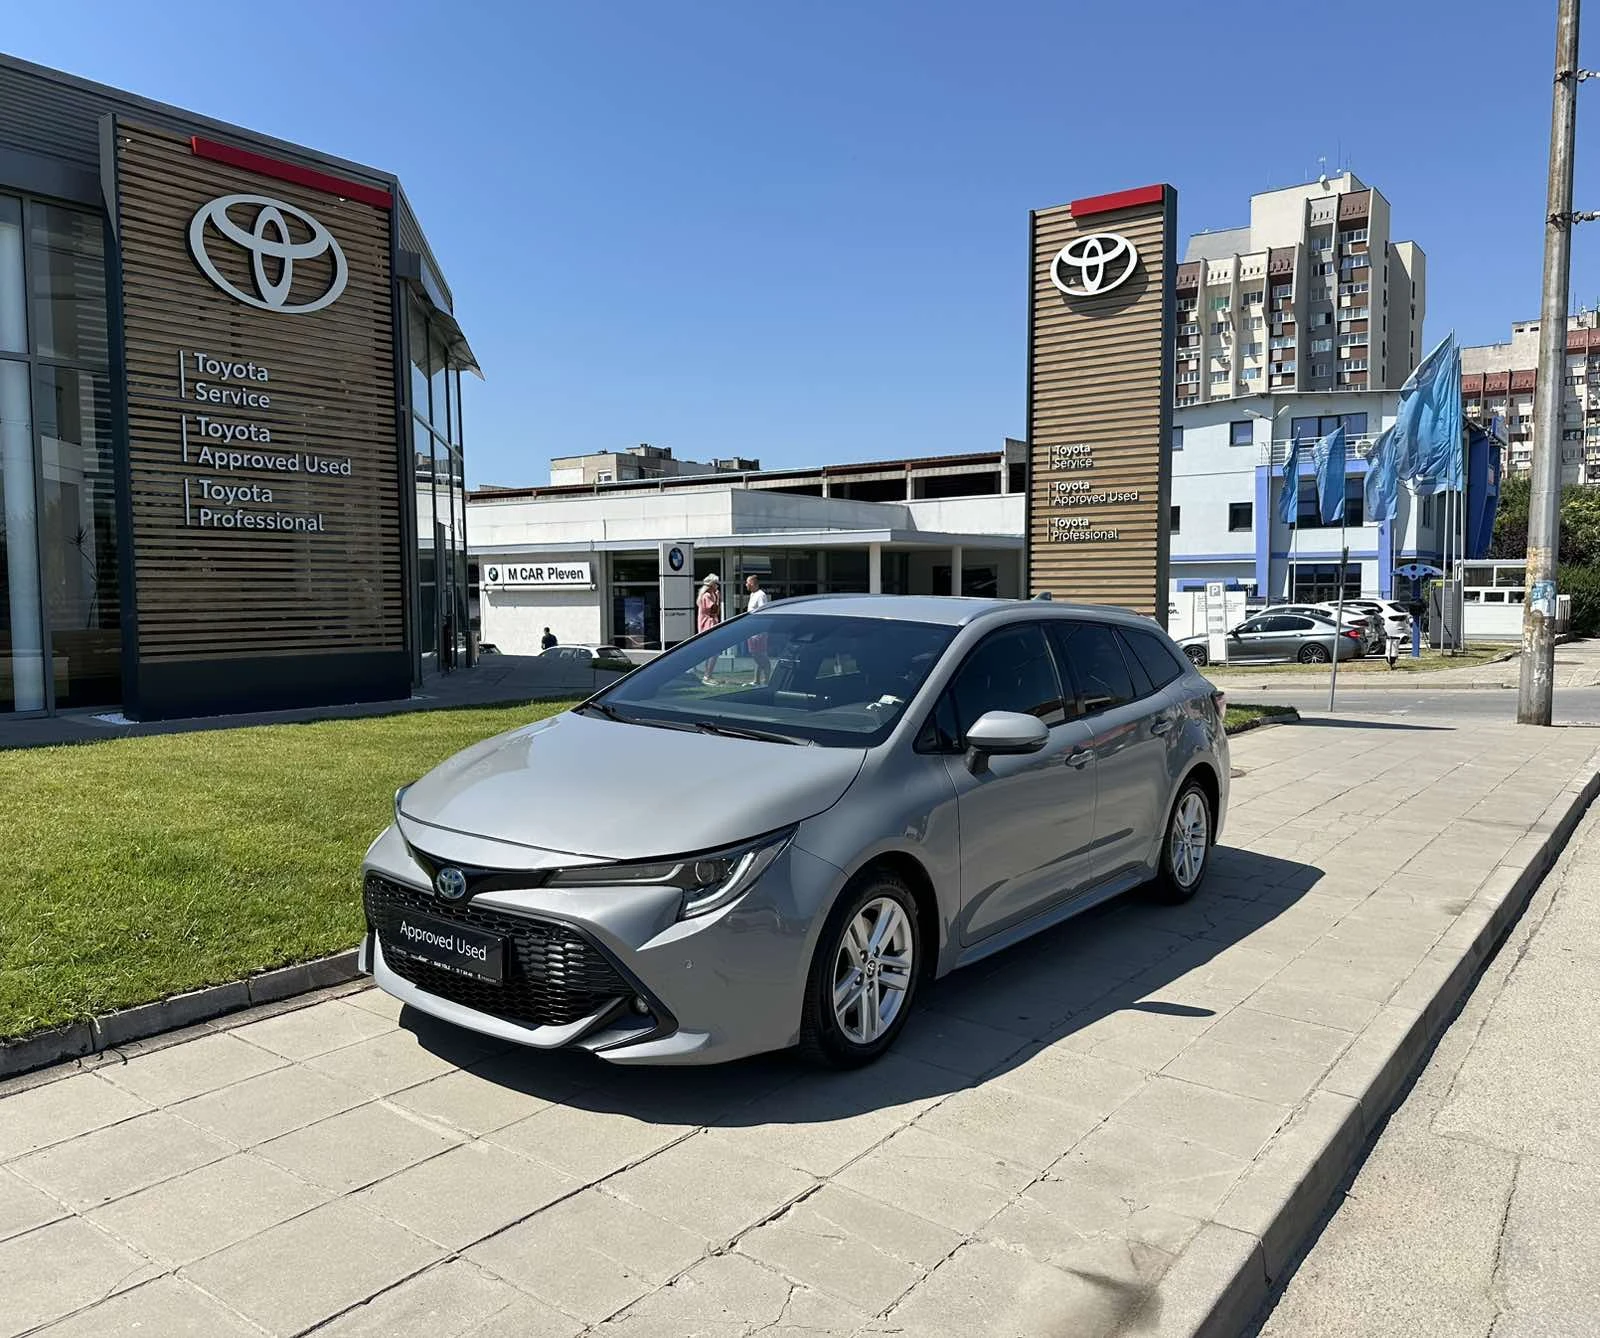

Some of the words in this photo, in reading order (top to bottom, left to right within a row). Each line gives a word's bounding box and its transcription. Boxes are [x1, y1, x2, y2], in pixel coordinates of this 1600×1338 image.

[194, 352, 269, 382] Toyota
[195, 382, 270, 408] Service
[197, 416, 271, 443] Toyota
[1055, 443, 1090, 456] Toyota
[198, 446, 299, 471] Approved
[305, 455, 351, 476] Used
[1054, 458, 1092, 469] Service
[199, 479, 273, 505] Toyota
[1055, 481, 1089, 493] Toyota
[1054, 491, 1106, 506] Approved
[1109, 490, 1138, 502] Used
[200, 508, 324, 532] Professional
[1054, 517, 1089, 529] Toyota
[1053, 528, 1117, 541] Professional
[508, 568, 518, 580] M
[520, 567, 544, 581] CAR
[547, 567, 584, 580] Pleven
[400, 920, 454, 951] Approved
[456, 937, 487, 962] Used
